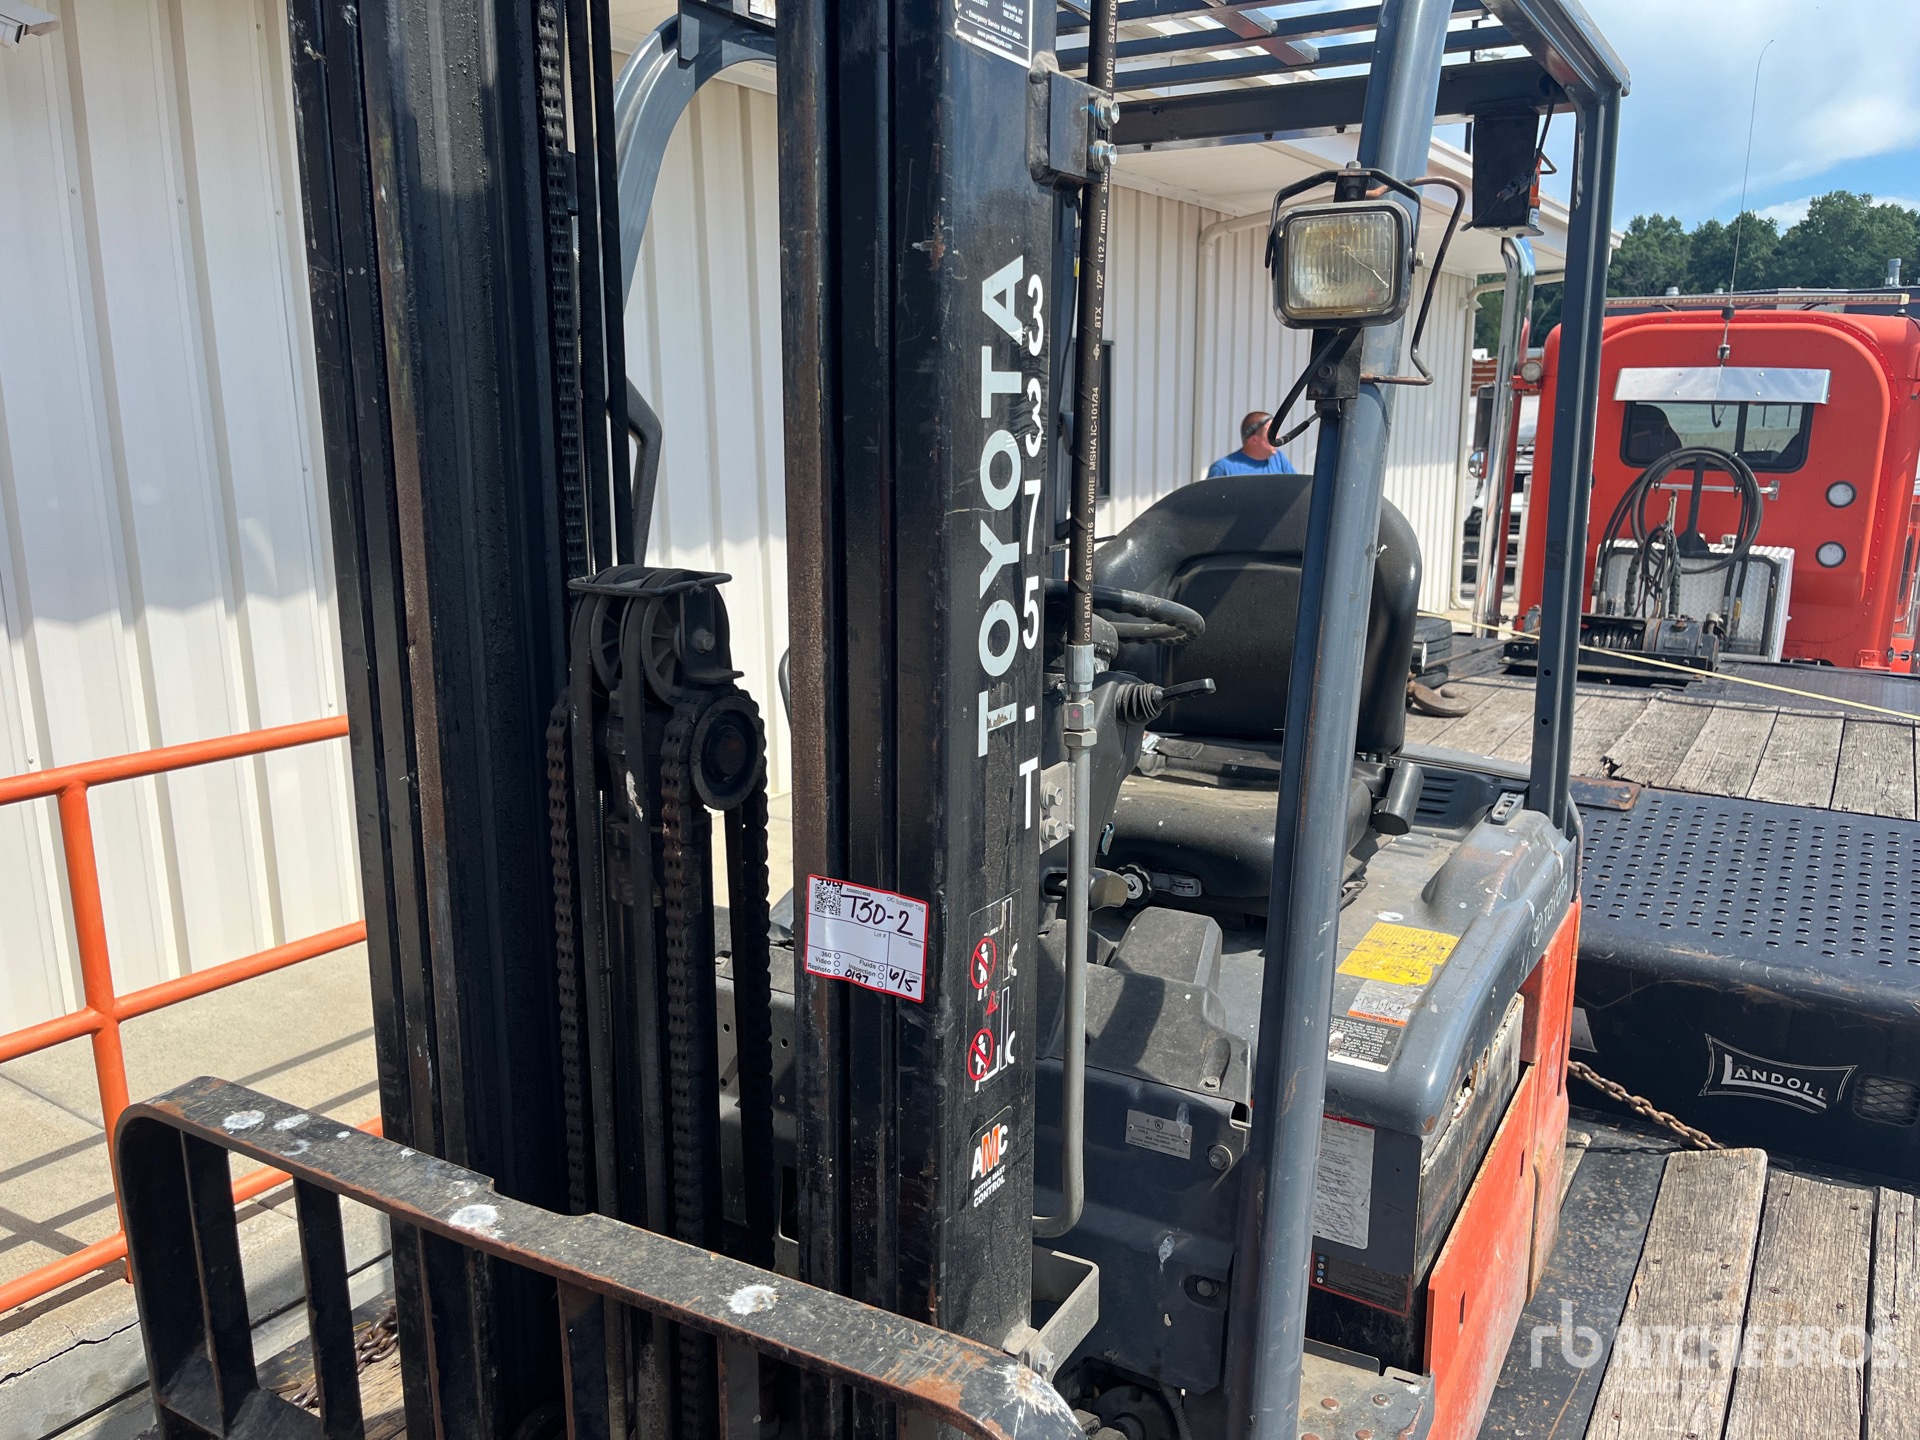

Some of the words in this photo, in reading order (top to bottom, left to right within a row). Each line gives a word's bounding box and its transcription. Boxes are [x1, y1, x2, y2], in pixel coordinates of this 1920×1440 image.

[1100, 209, 1108, 234] mm)
[1097, 236, 1106, 263] (12.7
[1089, 437, 1098, 470] MSHA
[1088, 475, 1096, 505] WIRE
[978, 255, 1024, 758] TOYOTA
[1085, 522, 1094, 581] SAE100R16
[1084, 593, 1092, 619] BAR)
[1544, 873, 1568, 928] TOYOTA
[908, 940, 922, 949] Notes
[808, 962, 831, 973] Rephoto
[815, 956, 831, 965] Video
[849, 963, 876, 977] Inspection
[859, 959, 876, 969] Fluids
[889, 968, 917, 992] 6/5
[1721, 1053, 1827, 1108] LANDOLL
[971, 1123, 1008, 1180] AMC
[973, 1175, 1006, 1208] CONTROL
[974, 1177, 992, 1197] ACTIVE
[991, 1165, 1006, 1182] MAST
